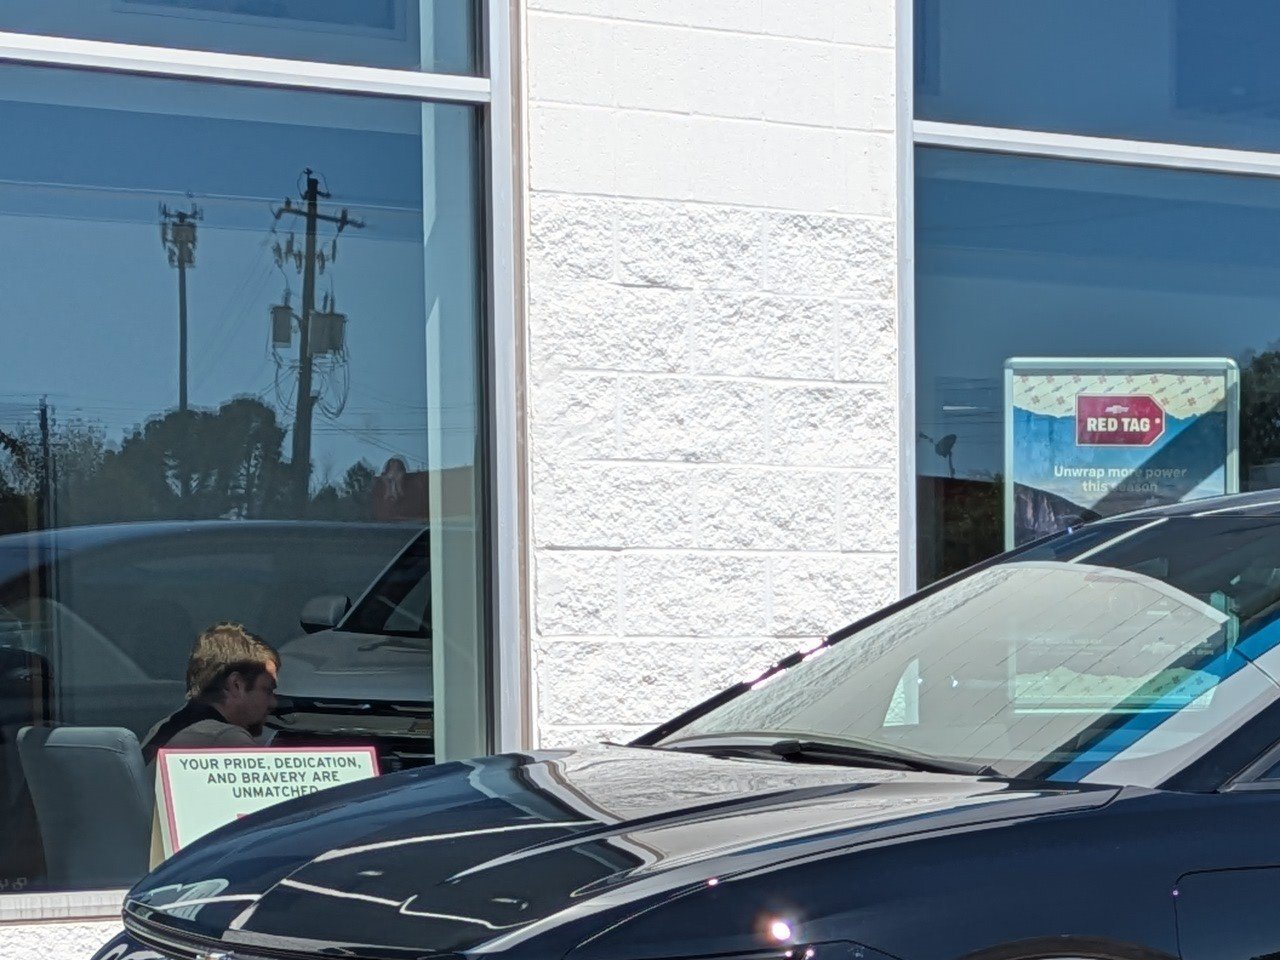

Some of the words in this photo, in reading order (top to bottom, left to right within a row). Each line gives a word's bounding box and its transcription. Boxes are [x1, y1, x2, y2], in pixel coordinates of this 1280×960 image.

[1087, 418, 1118, 432] RED
[1121, 417, 1150, 432] TAG
[1054, 465, 1105, 478] Unwrap
[1108, 468, 1142, 478] more
[1146, 468, 1187, 479] power
[1082, 481, 1108, 492] this
[179, 757, 219, 770] YOUR
[224, 757, 270, 769] PRIDE,
[275, 757, 361, 769] DEDICATION,
[207, 772, 236, 784] AND
[242, 771, 306, 783] BRAVERY
[312, 771, 339, 782] ARE
[232, 785, 319, 799] UNMATCHED
